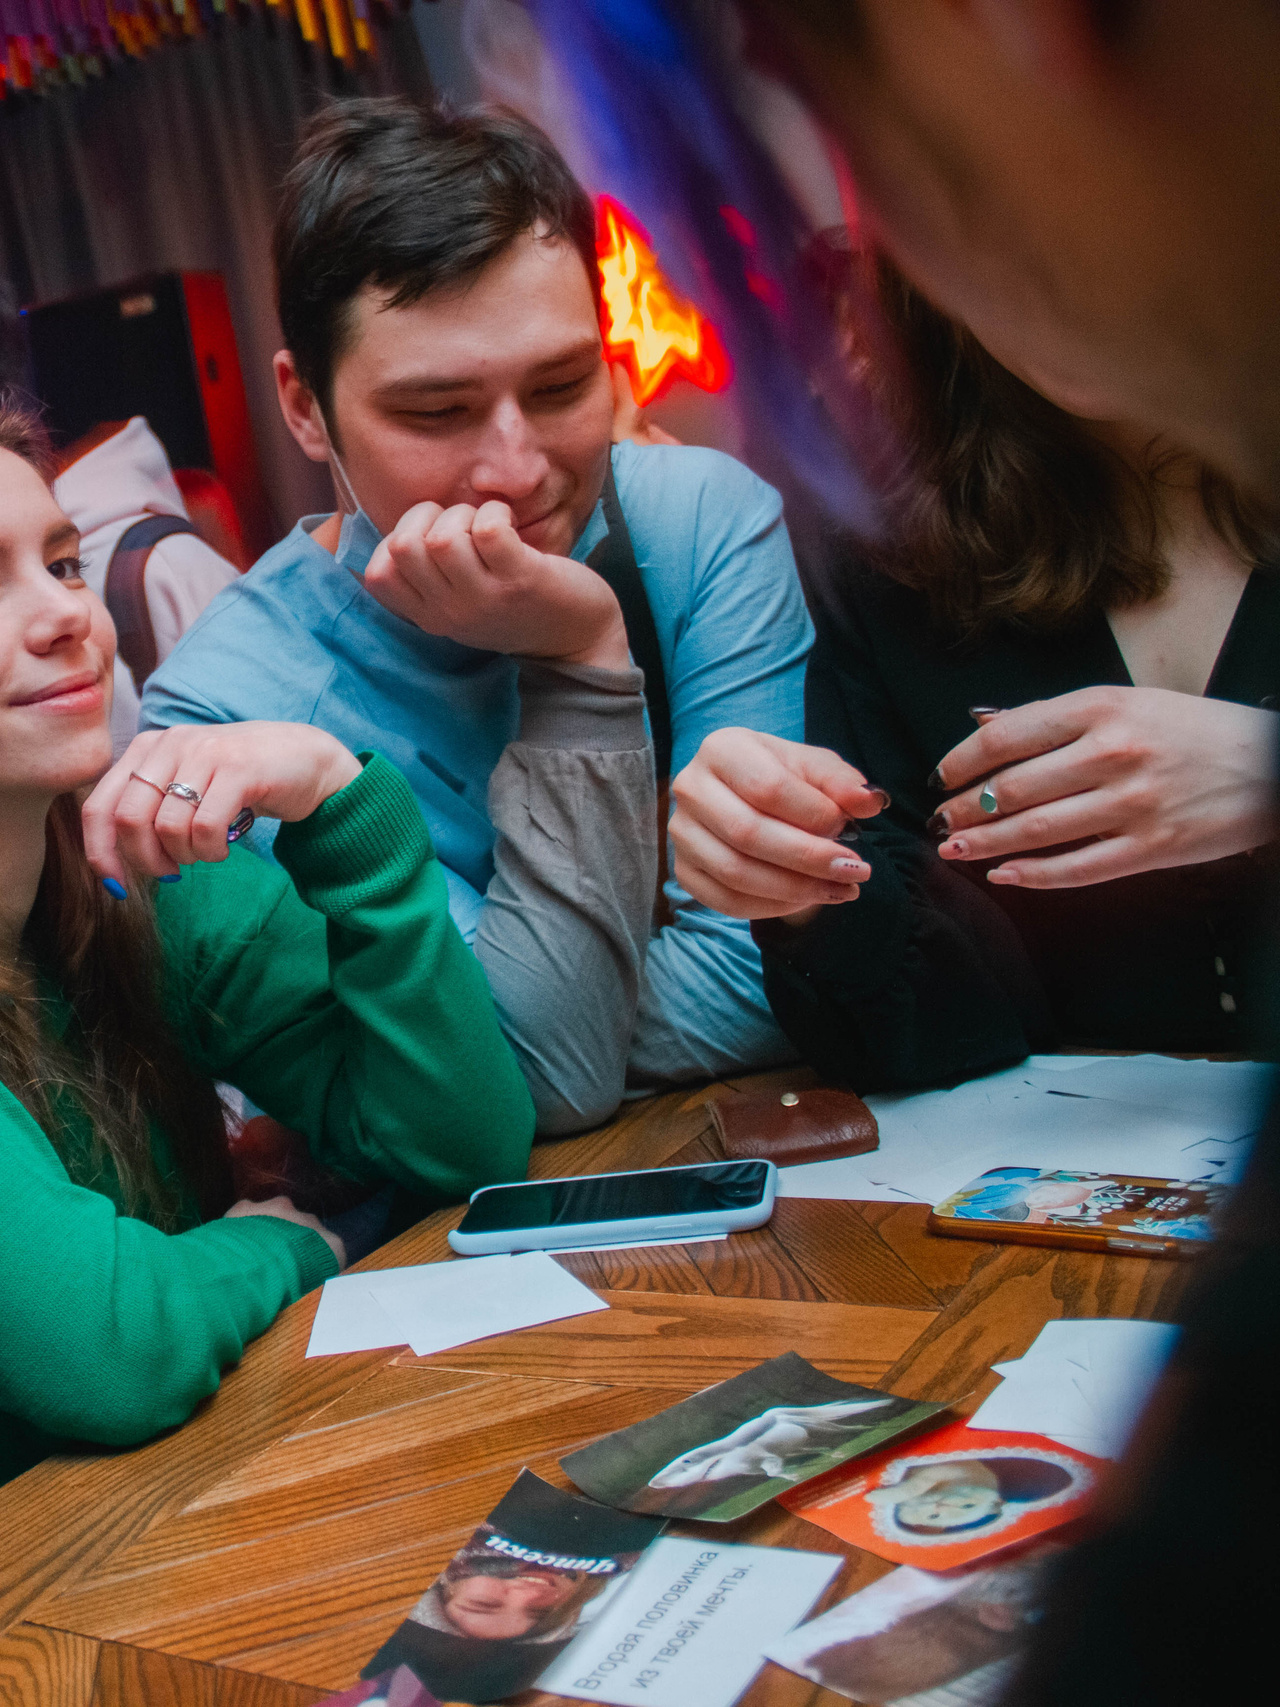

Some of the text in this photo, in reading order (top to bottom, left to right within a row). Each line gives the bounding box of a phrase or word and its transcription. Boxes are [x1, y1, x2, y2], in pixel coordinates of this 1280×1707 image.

[573, 1551, 719, 1690] Вторая половинка
[631, 1563, 755, 1689] из твоей мечты.
